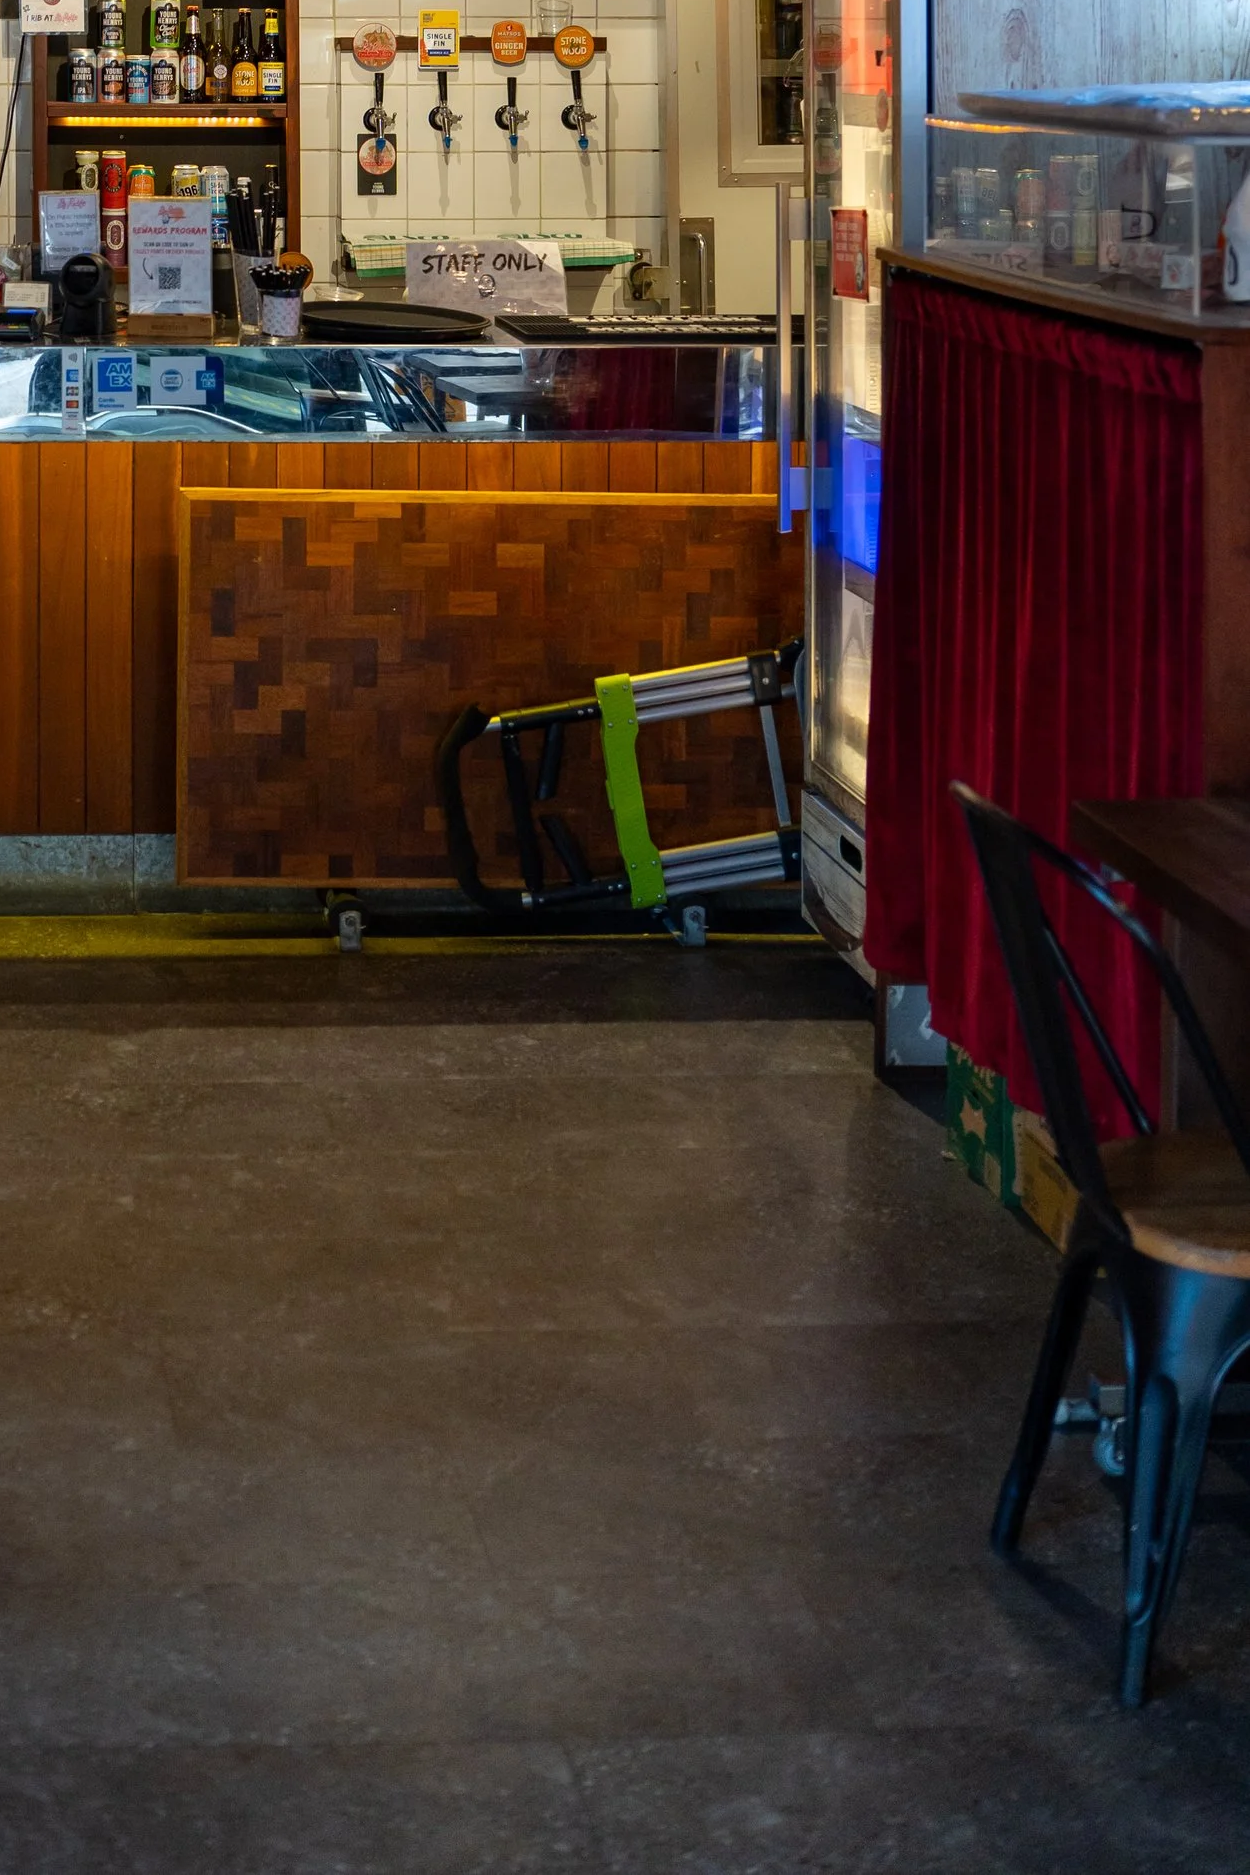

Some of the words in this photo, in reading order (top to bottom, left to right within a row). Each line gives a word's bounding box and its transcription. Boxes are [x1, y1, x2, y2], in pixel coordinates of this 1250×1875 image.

[494, 42, 524, 50] GINGER
[560, 37, 587, 46] STONE
[133, 226, 168, 235] REWARDS
[169, 226, 208, 235] PROGRAM
[422, 253, 486, 274] STAFF
[492, 253, 547, 272] ONLY
